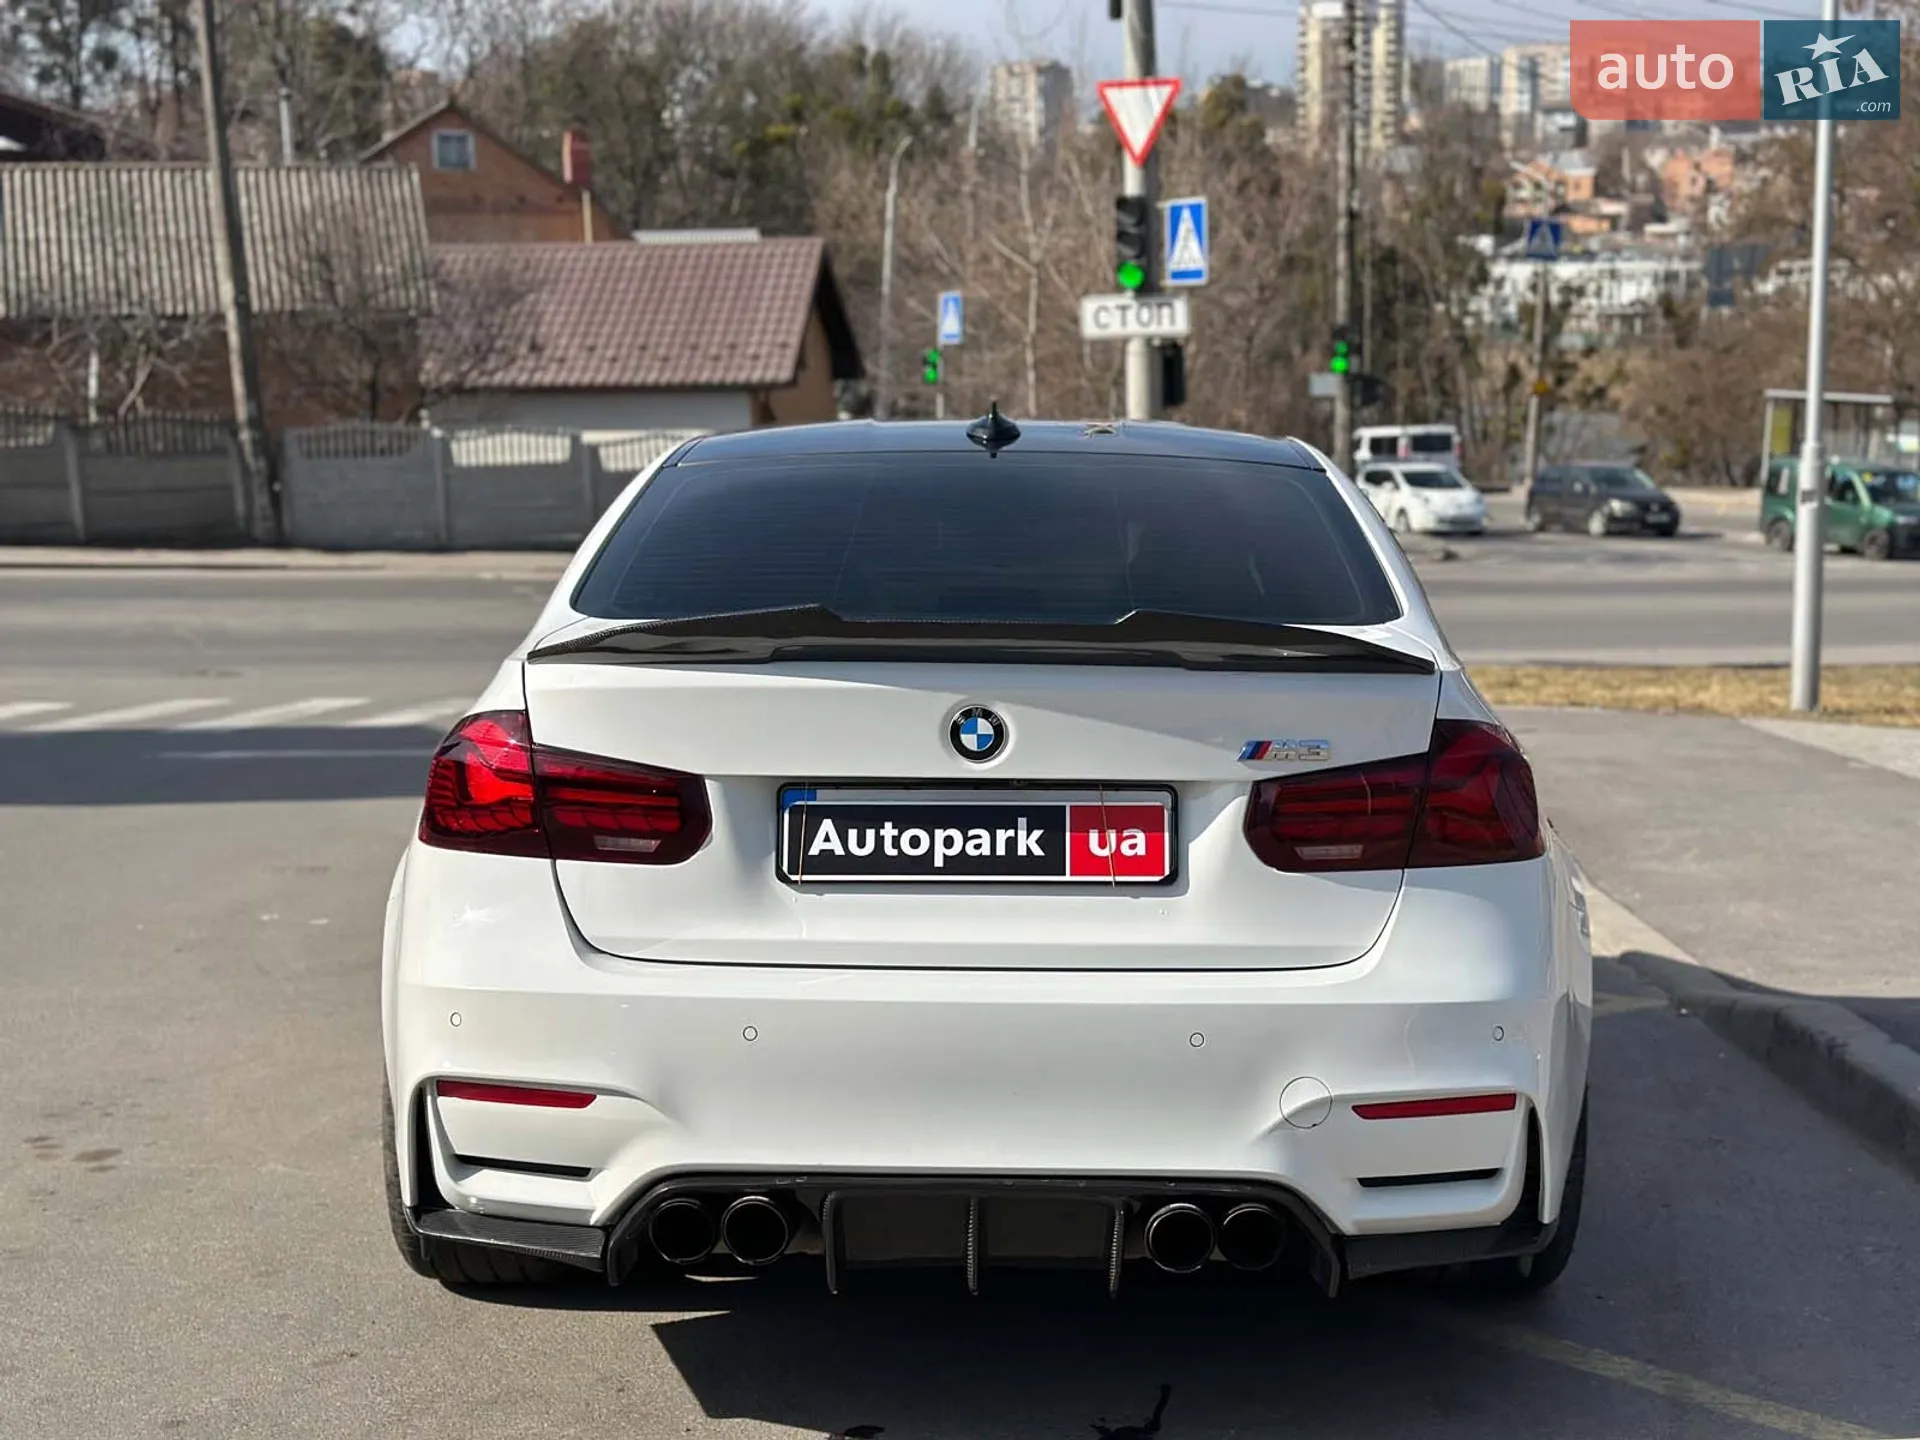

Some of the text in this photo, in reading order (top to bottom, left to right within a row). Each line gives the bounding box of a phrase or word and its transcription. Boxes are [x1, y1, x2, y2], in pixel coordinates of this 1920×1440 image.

[1093, 302, 1176, 330] СТОП
[1262, 739, 1331, 761] M3
[807, 817, 1147, 868] Autopark ua
